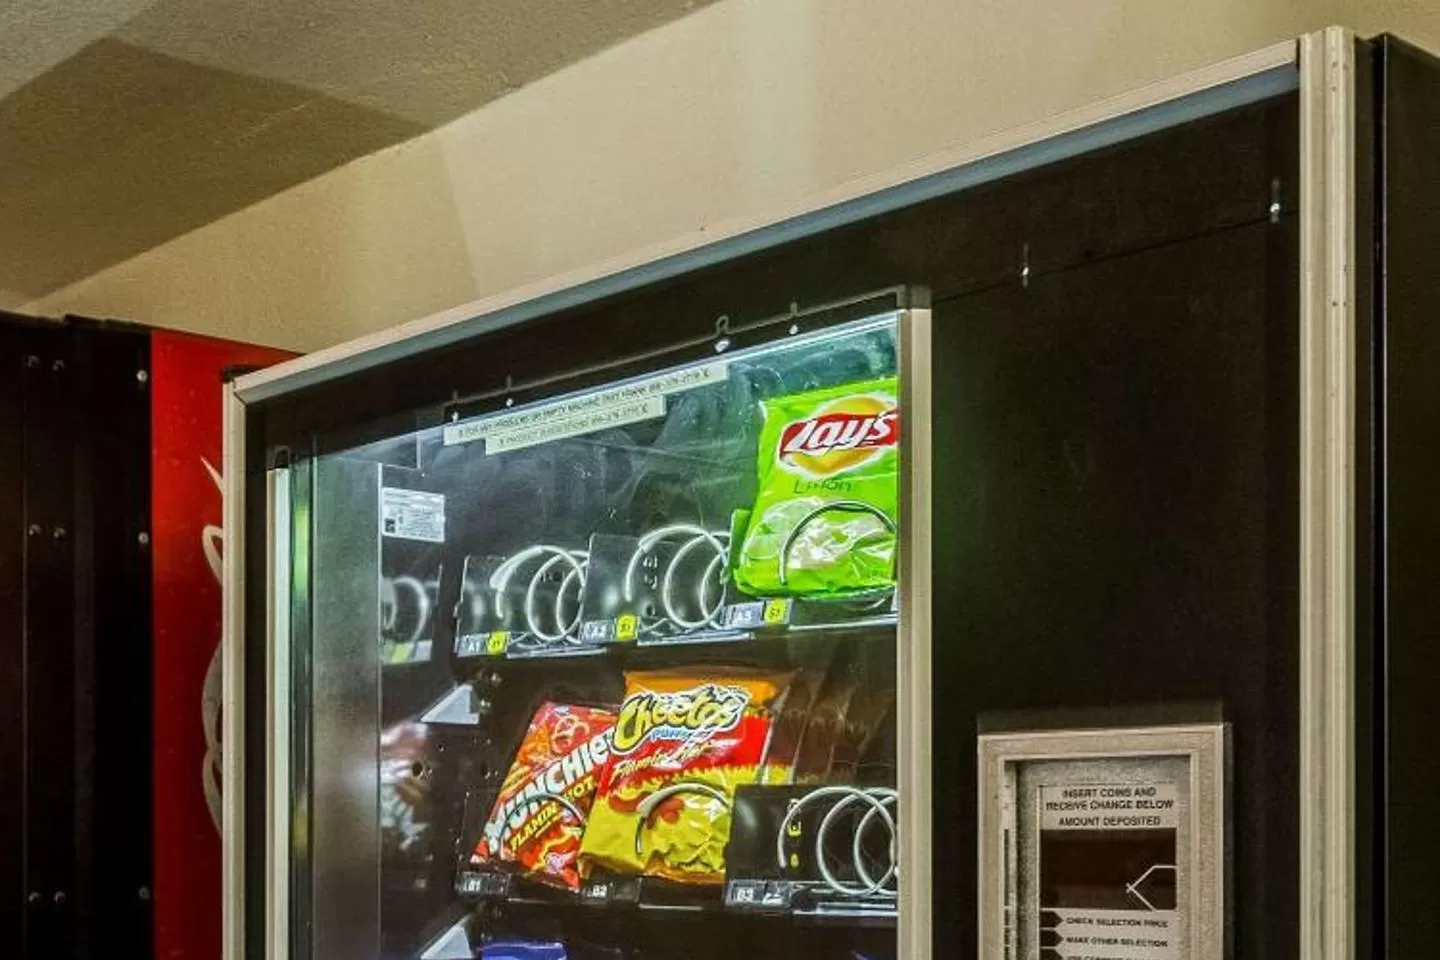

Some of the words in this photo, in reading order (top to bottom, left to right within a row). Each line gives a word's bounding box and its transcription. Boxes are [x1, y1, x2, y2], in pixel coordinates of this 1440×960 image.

[613, 685, 749, 751] Cheetos
[1062, 789, 1098, 798] INSERT
[1100, 788, 1132, 797] COINS
[1134, 787, 1157, 797] AND
[1046, 801, 1088, 811] RECEIVE
[1090, 800, 1133, 809] CHANGE
[1136, 800, 1174, 809] BELOW
[1059, 817, 1100, 826] AMOUNT
[1104, 815, 1160, 826] DEPOSITED
[1120, 938, 1168, 947] SELECTION
